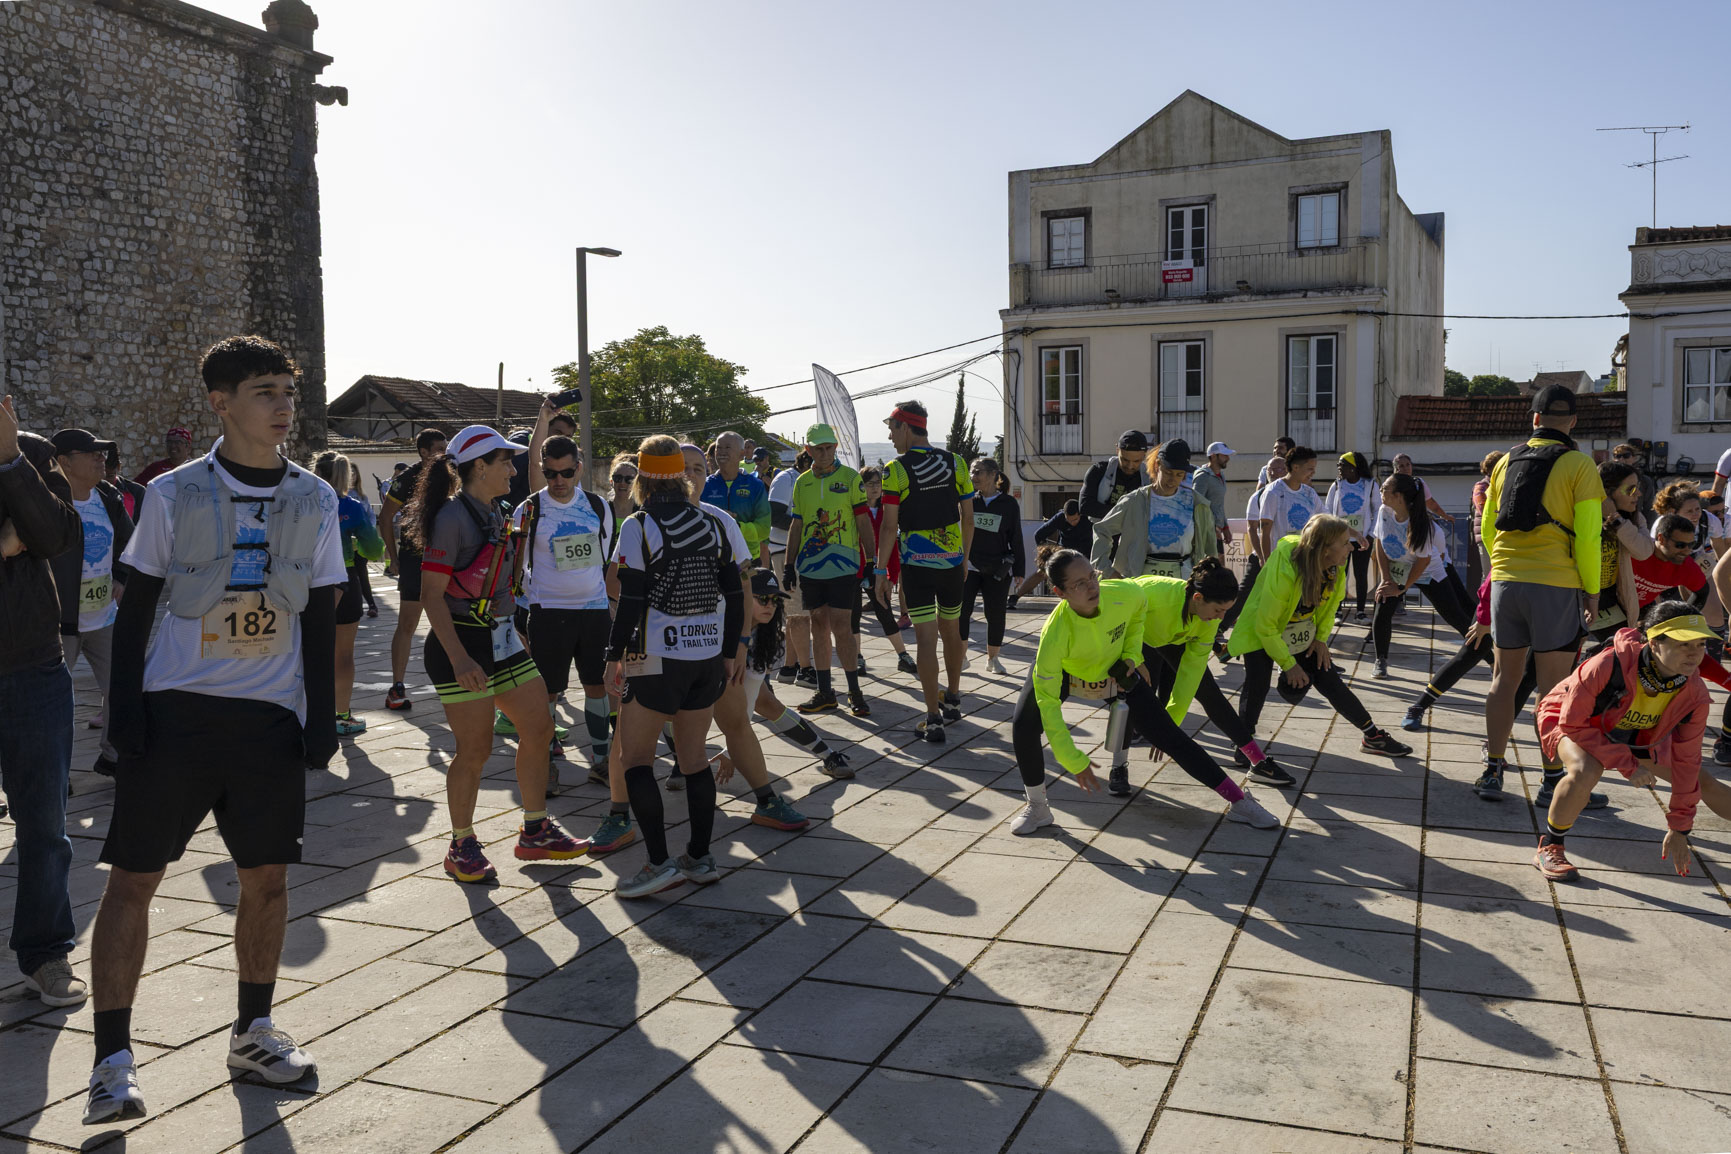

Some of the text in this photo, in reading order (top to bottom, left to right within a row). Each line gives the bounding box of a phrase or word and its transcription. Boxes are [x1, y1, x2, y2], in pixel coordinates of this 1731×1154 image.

[976, 517, 994, 526] 333
[565, 543, 592, 559] 569
[1390, 566, 1404, 577] 444
[85, 584, 108, 600] 409
[224, 610, 277, 637] 182
[680, 623, 718, 637] CORVUS
[682, 639, 703, 649] TRAIL
[1290, 630, 1310, 645] 348
